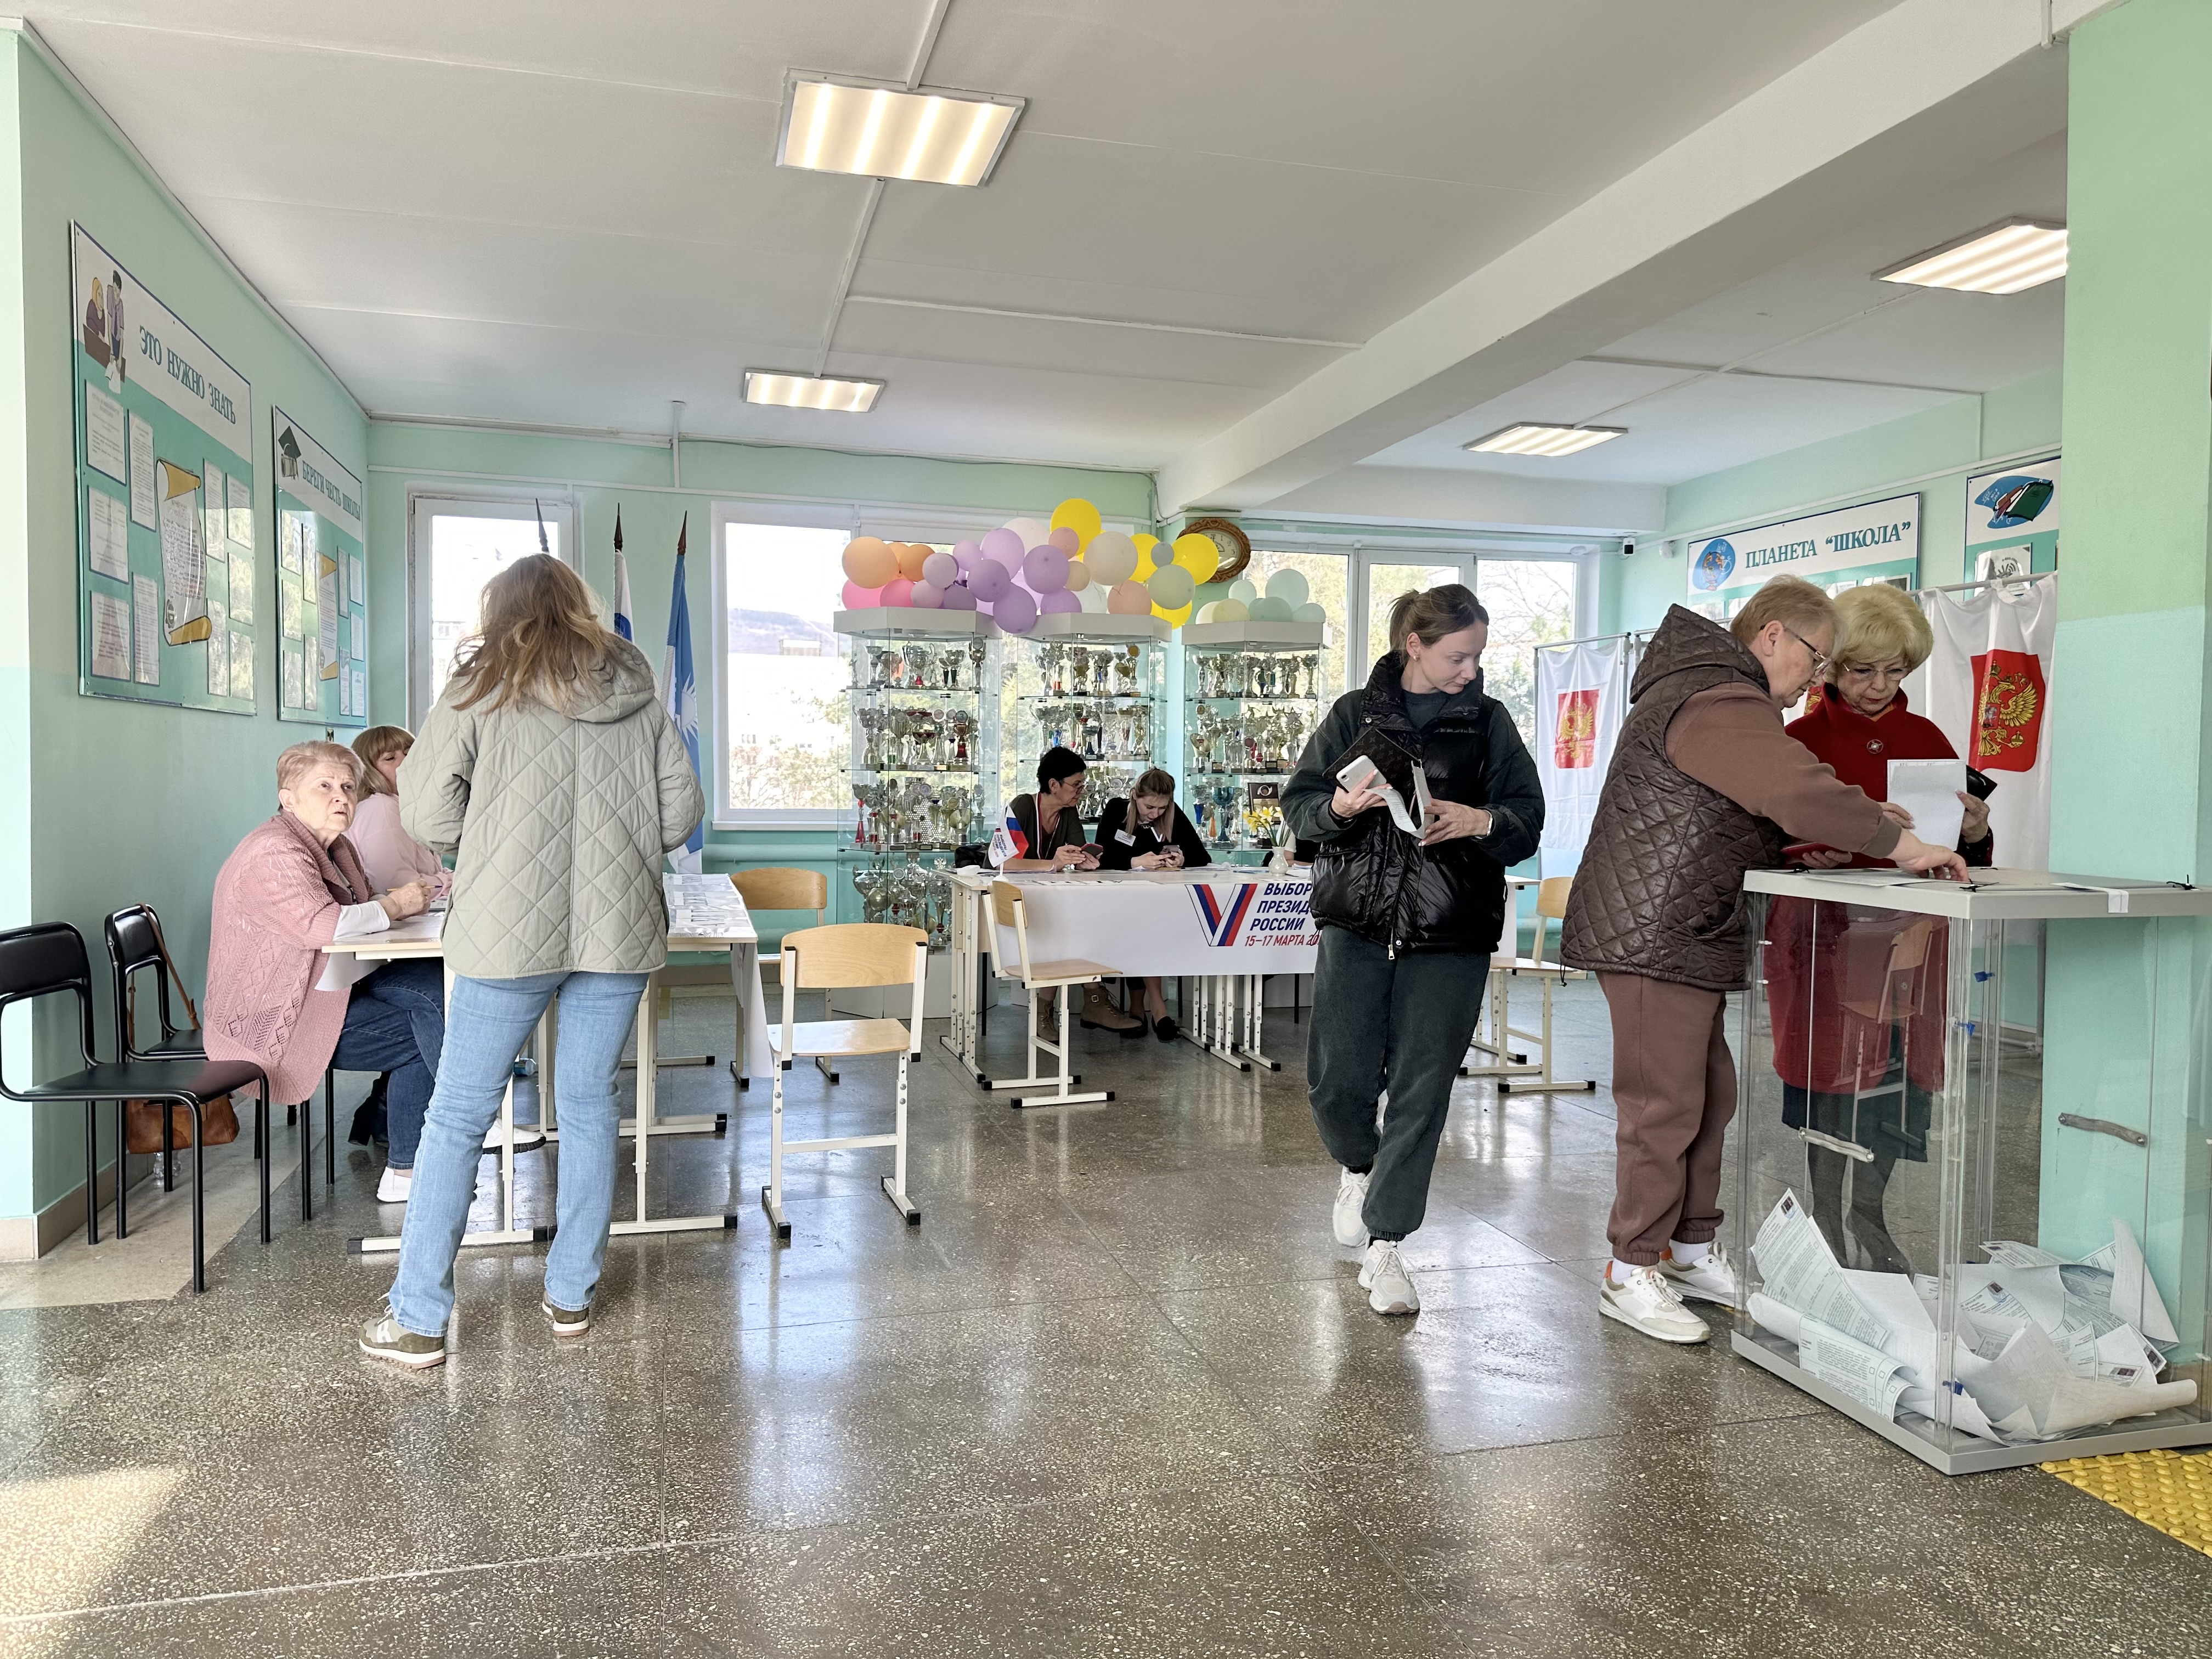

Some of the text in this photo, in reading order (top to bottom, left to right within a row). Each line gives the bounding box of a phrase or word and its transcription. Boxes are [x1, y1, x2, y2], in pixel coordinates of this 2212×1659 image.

[139, 324, 236, 425] ЭТО НУЖНО ЗНАТЬ
[302, 460, 325, 494] БЕРЕГИ
[325, 478, 342, 507] ЧЕСТЬ
[1745, 539, 1818, 569] ПЛАНЕТА
[1263, 883, 1312, 896] ВЫБОР
[1256, 900, 1311, 915] ПРЕЗИД
[1250, 917, 1306, 932] РОССИИ
[1273, 934, 1305, 946] МАРТА
[1306, 934, 1322, 946] 20
